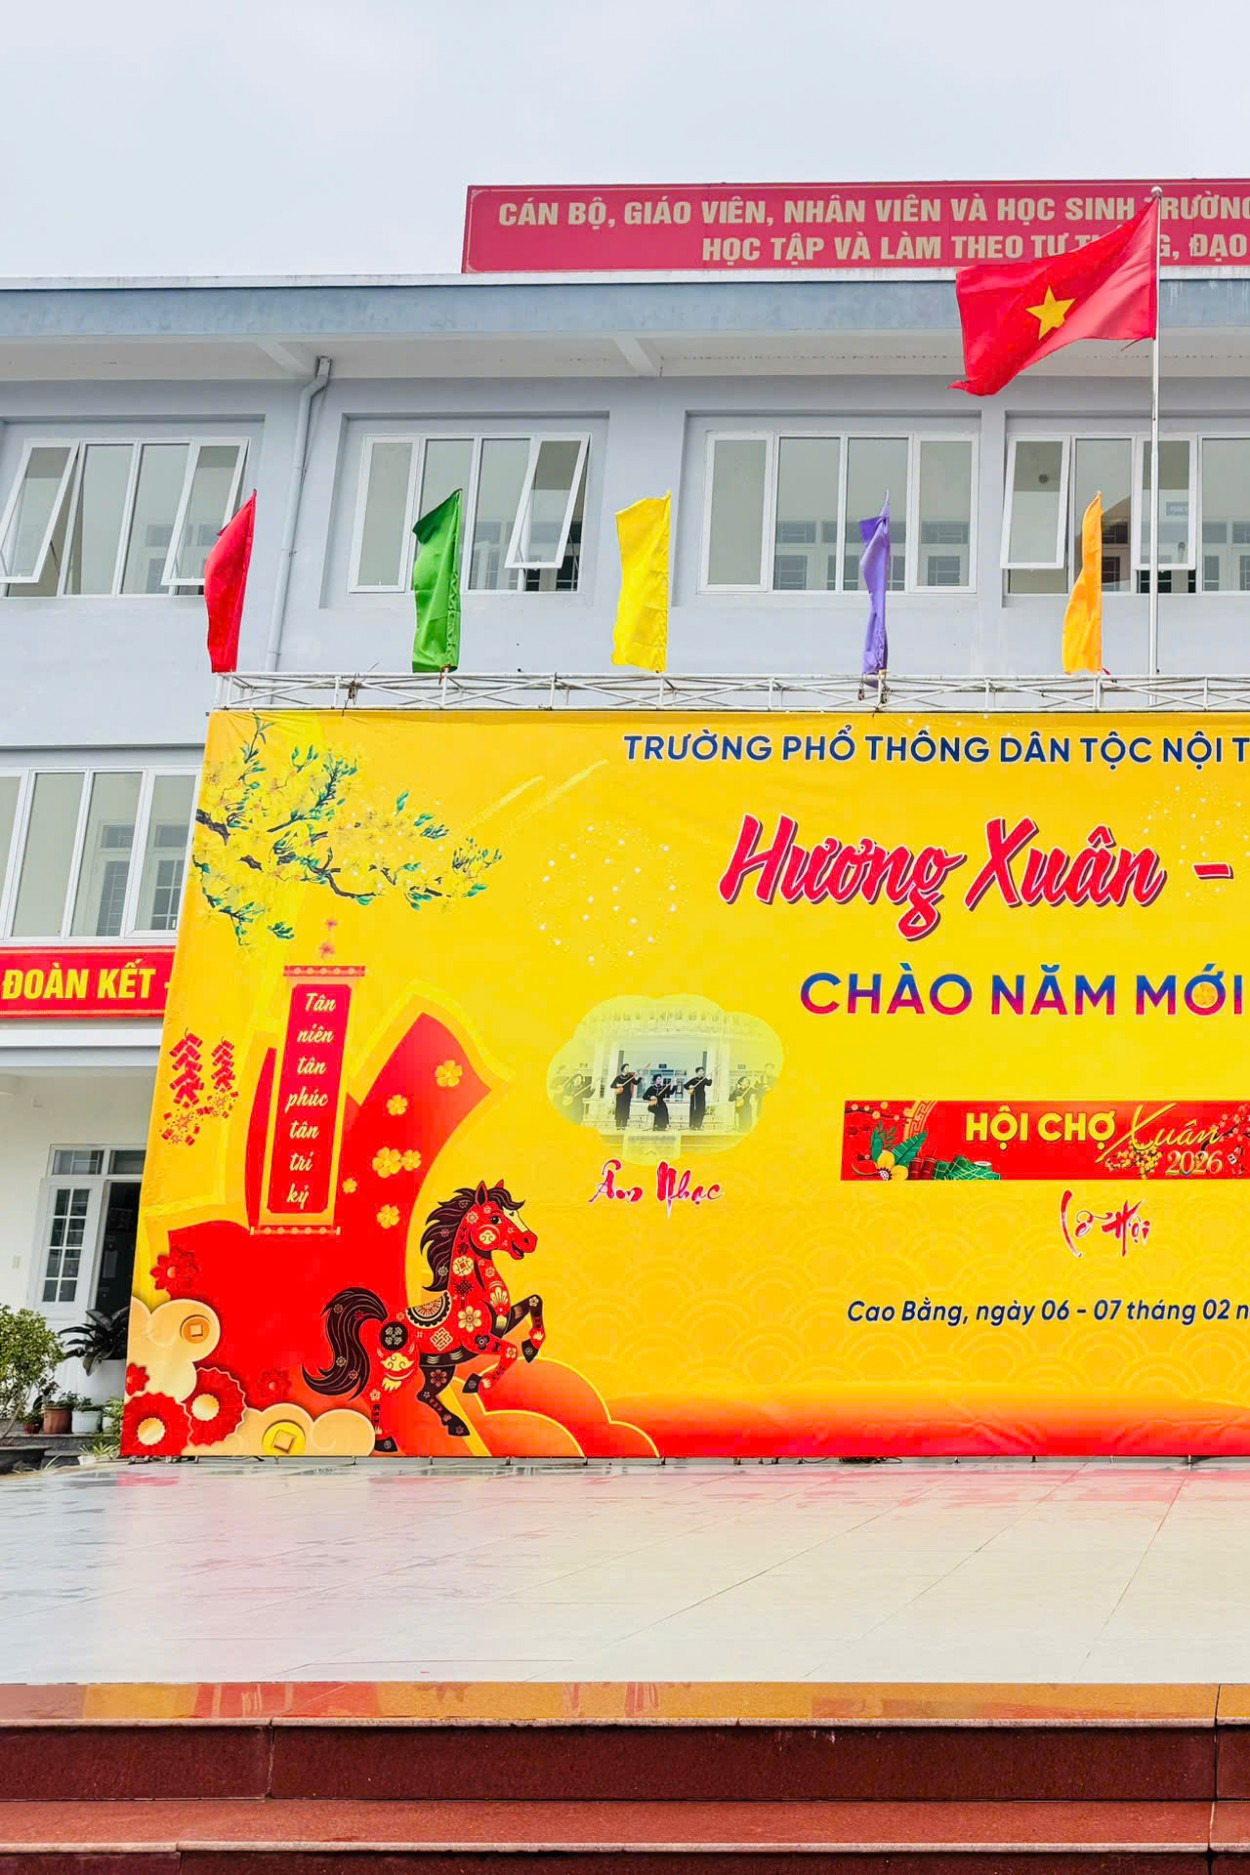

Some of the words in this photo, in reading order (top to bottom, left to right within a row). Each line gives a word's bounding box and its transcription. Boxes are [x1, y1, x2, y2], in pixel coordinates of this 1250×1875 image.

[499, 197, 558, 226] CÁN
[568, 196, 615, 230] BỘ,
[624, 195, 691, 225] GIÁO
[701, 195, 774, 227] VIÊN,
[783, 194, 866, 223] NHÂN
[875, 193, 941, 223] VIÊN
[950, 192, 988, 222] VÀ
[996, 197, 1055, 226] HỌC
[1065, 197, 1135, 221] SINH
[701, 237, 761, 266] HỌC
[770, 232, 824, 266] TẬP
[833, 230, 871, 261] VÀ
[880, 230, 941, 260] LÀM
[951, 235, 1024, 260] THEO
[1030, 232, 1069, 258] TƯ
[1188, 232, 1248, 262] ĐẠO
[623, 728, 772, 762] TRƯỜNG
[782, 723, 857, 761] PHỔ
[865, 729, 990, 763] THÔNG
[1000, 730, 1071, 763] DÂN
[1079, 730, 1152, 770] TỘC
[1162, 730, 1223, 770] NỘI
[718, 813, 967, 942] Hương
[964, 815, 1168, 910] Xuân
[2, 962, 90, 999] ĐOÀN
[97, 958, 157, 999] KẾT
[799, 962, 973, 1016] CHÀO
[990, 963, 1116, 1016] NĂM
[1135, 963, 1243, 1016] MỚI
[305, 992, 336, 1012] Tân
[297, 1023, 334, 1043] niên
[296, 1056, 327, 1075] tân
[285, 1085, 329, 1114] phúc
[289, 1119, 320, 1139] tân
[966, 1105, 1029, 1150] HỘI
[1037, 1109, 1116, 1150] CHỢ
[1094, 1102, 1221, 1163] Xuân
[1164, 1149, 1223, 1176] 2026
[587, 1158, 644, 1204] Âm
[656, 1160, 722, 1219] Nhạc
[847, 1300, 895, 1322] Cao
[901, 1297, 969, 1327] Bằng,
[976, 1299, 1036, 1326] ngày
[1041, 1299, 1070, 1321] 06
[1093, 1299, 1123, 1321] 07
[1127, 1299, 1196, 1326] tháng
[1202, 1299, 1231, 1320] 02
